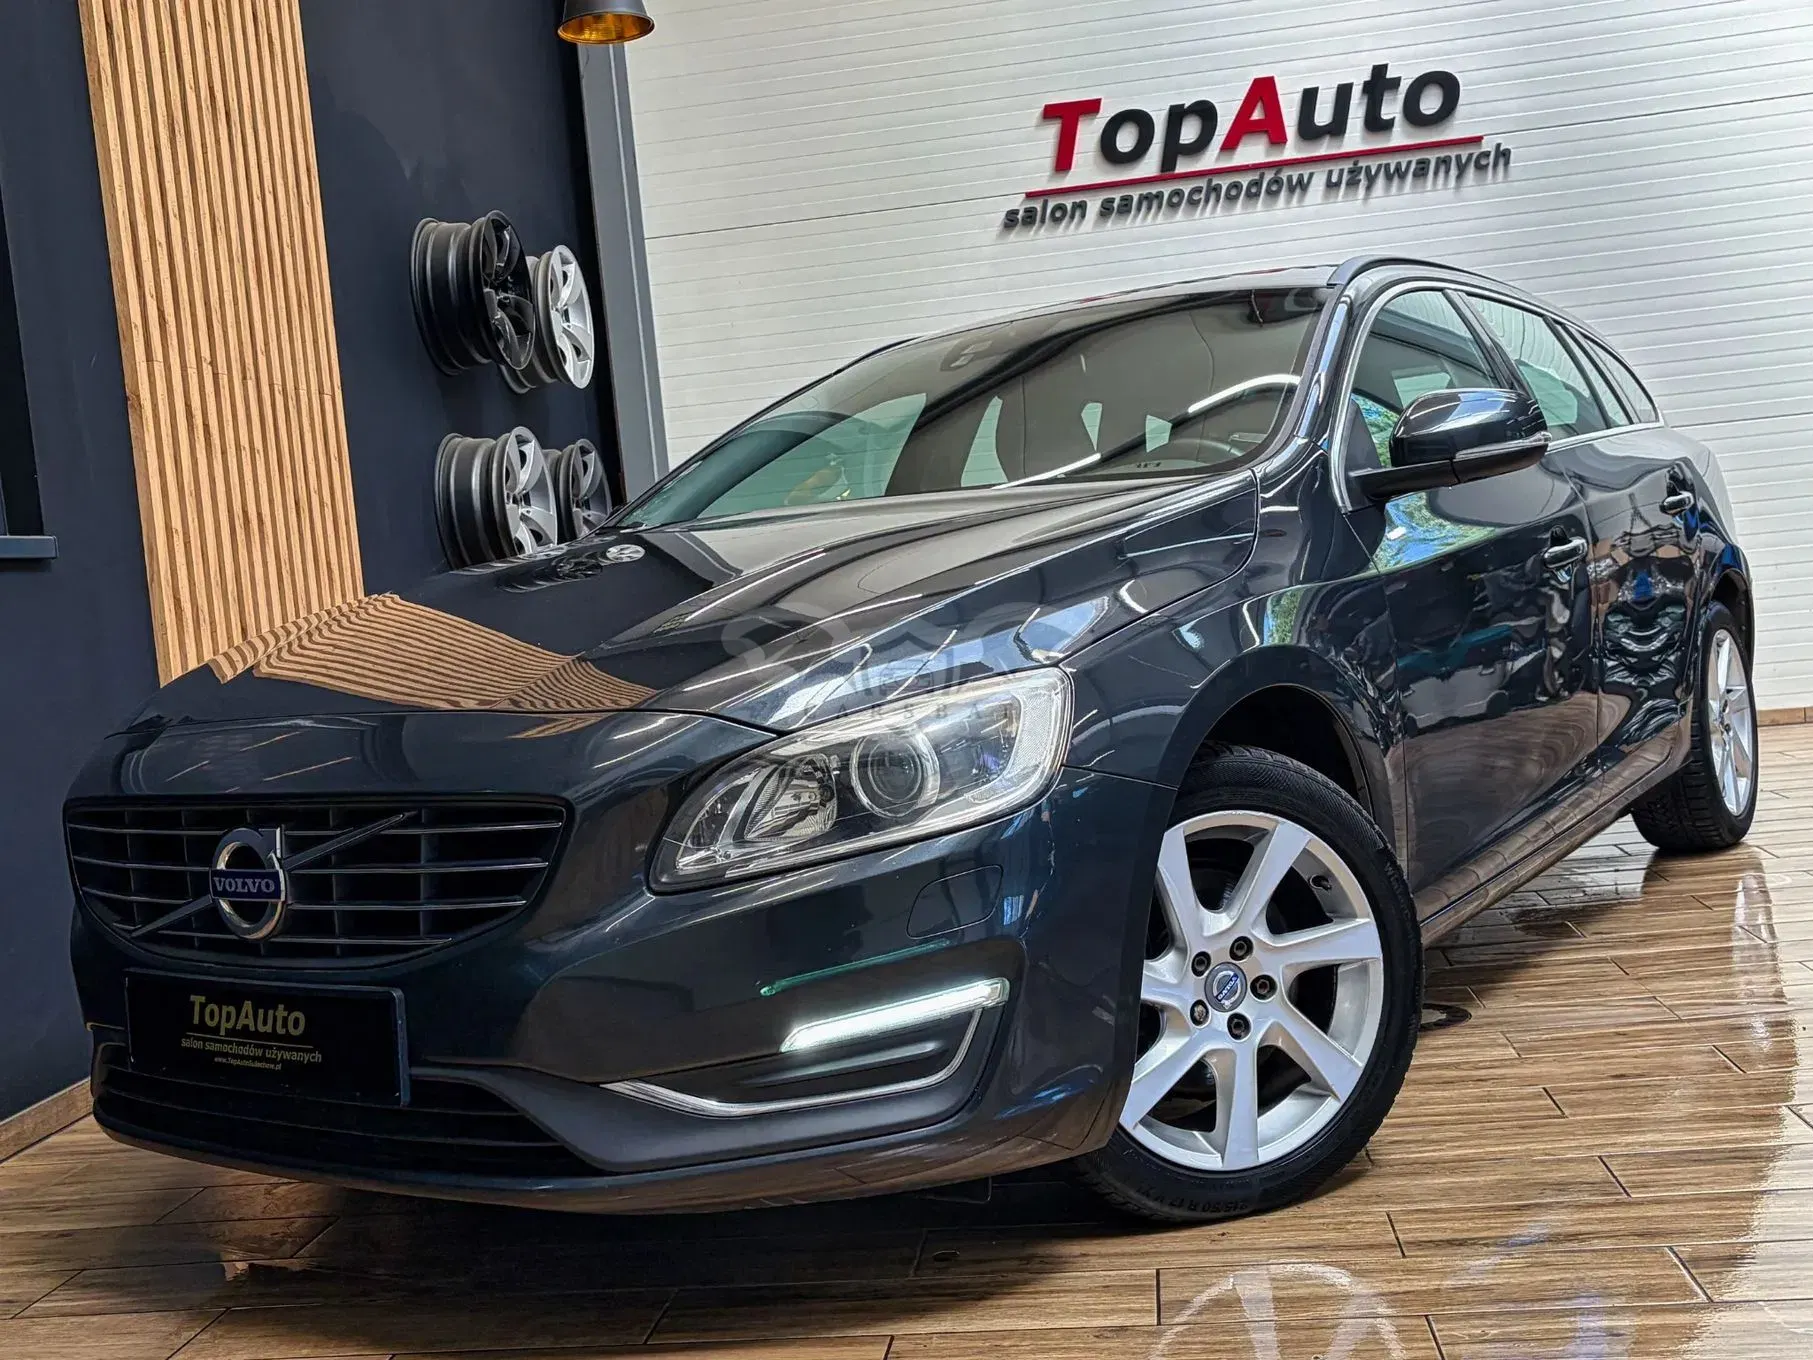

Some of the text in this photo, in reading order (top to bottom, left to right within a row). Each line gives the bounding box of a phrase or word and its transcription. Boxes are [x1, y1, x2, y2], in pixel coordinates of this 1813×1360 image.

[1043, 63, 1461, 174] TopAuto
[1003, 143, 1512, 228] salon samochodów używanych
[212, 877, 276, 893] VOLVO
[189, 994, 306, 1036] TopAuto
[181, 1037, 322, 1064] salon samochodów używanych
